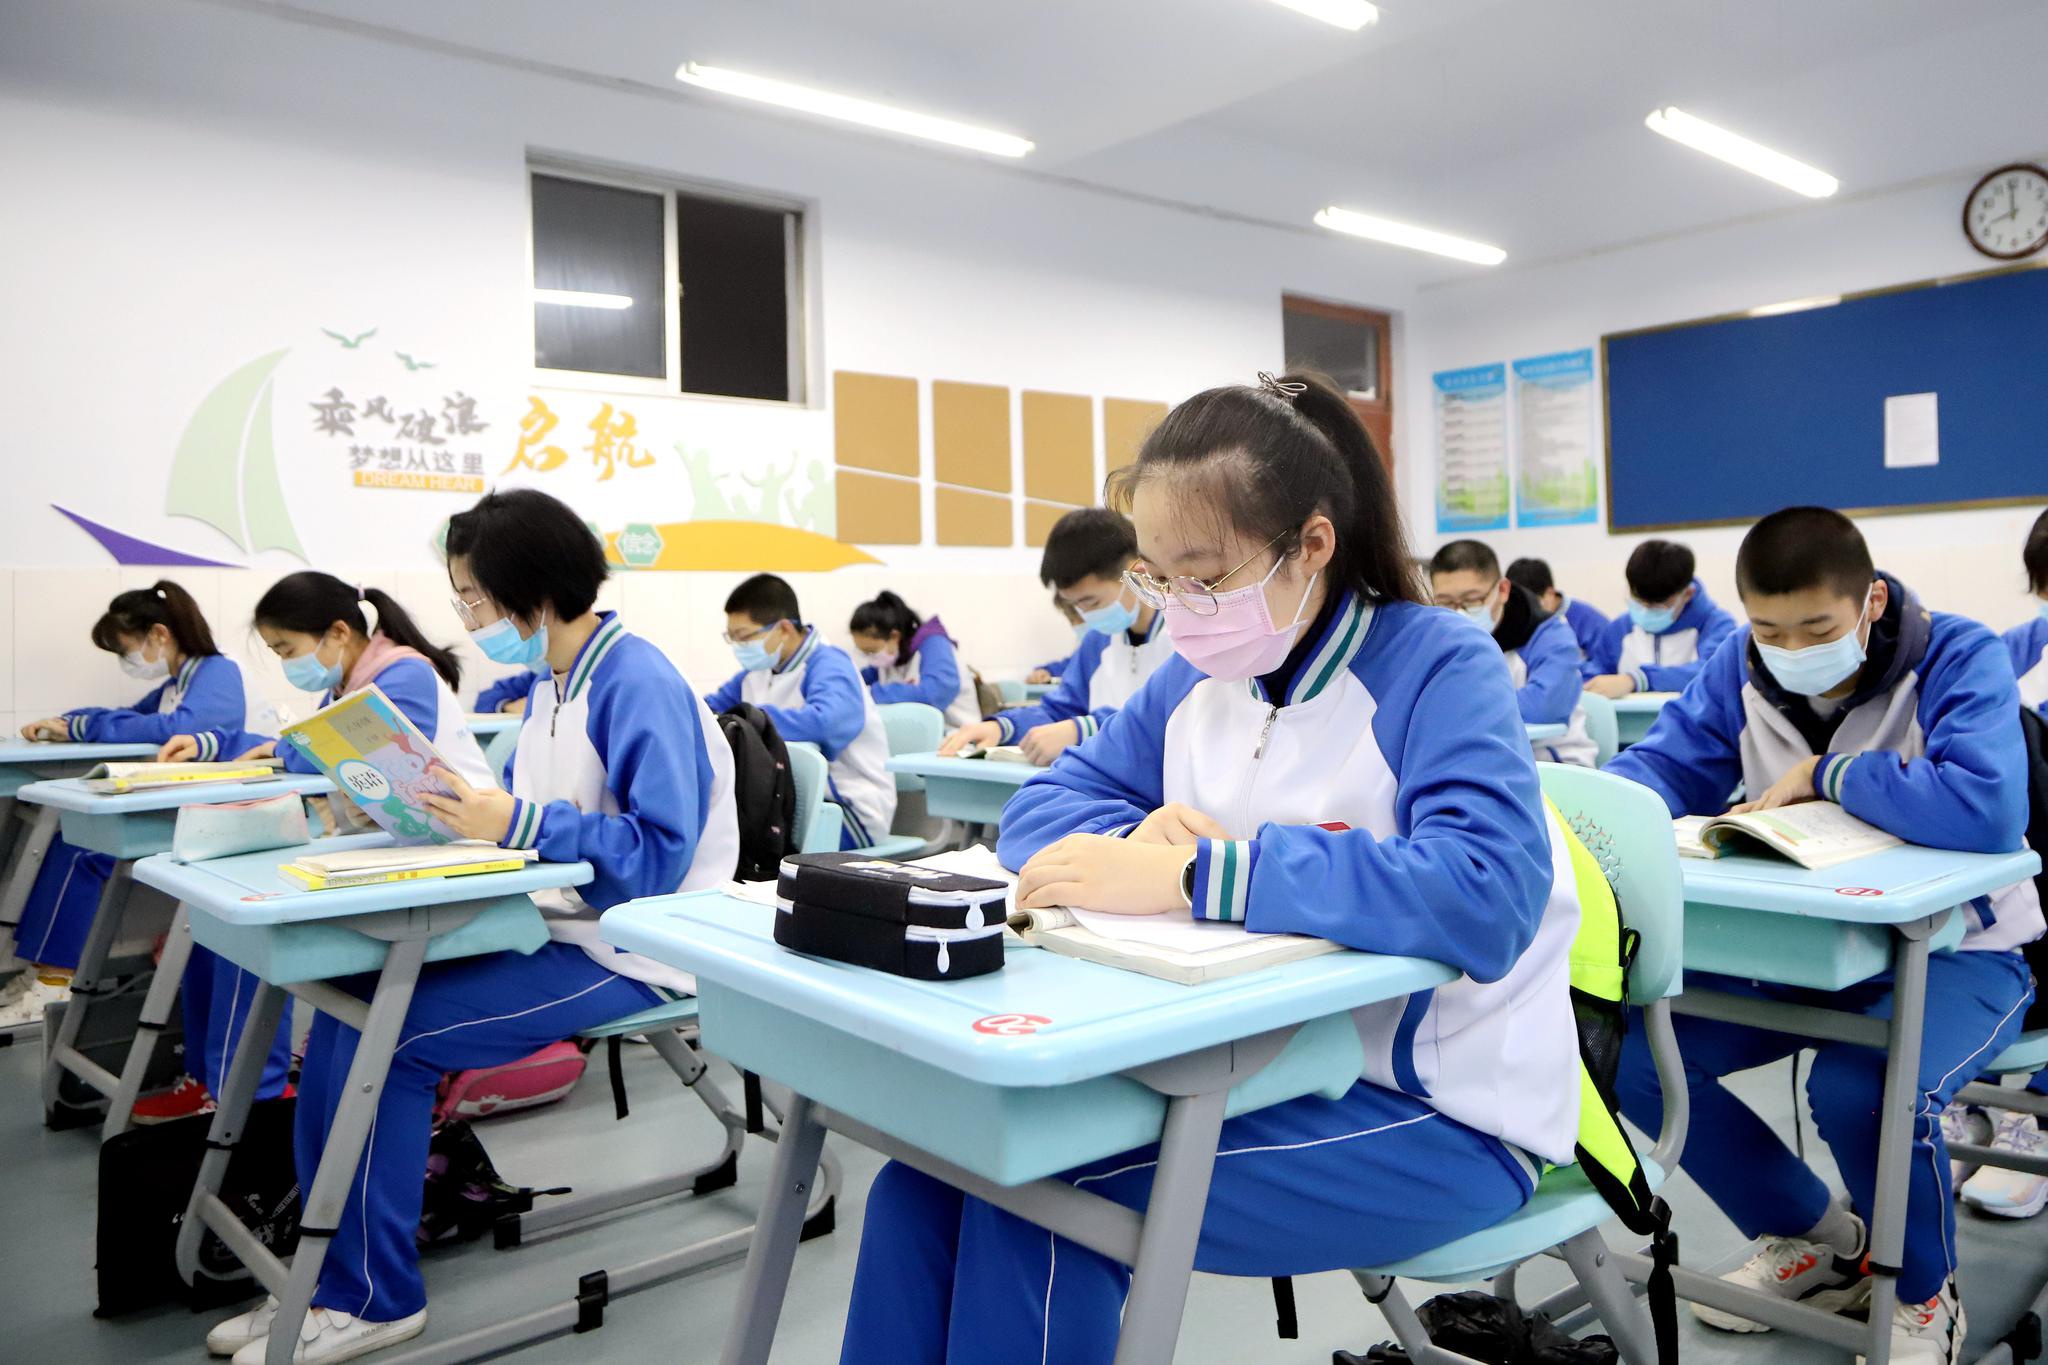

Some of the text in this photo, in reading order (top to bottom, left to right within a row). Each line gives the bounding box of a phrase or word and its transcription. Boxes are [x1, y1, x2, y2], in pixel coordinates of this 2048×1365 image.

[309, 386, 490, 445] 乘风破浪
[349, 445, 484, 475] 梦想从这里
[500, 395, 657, 482] 启航
[361, 470, 476, 491] DREAM HEAR
